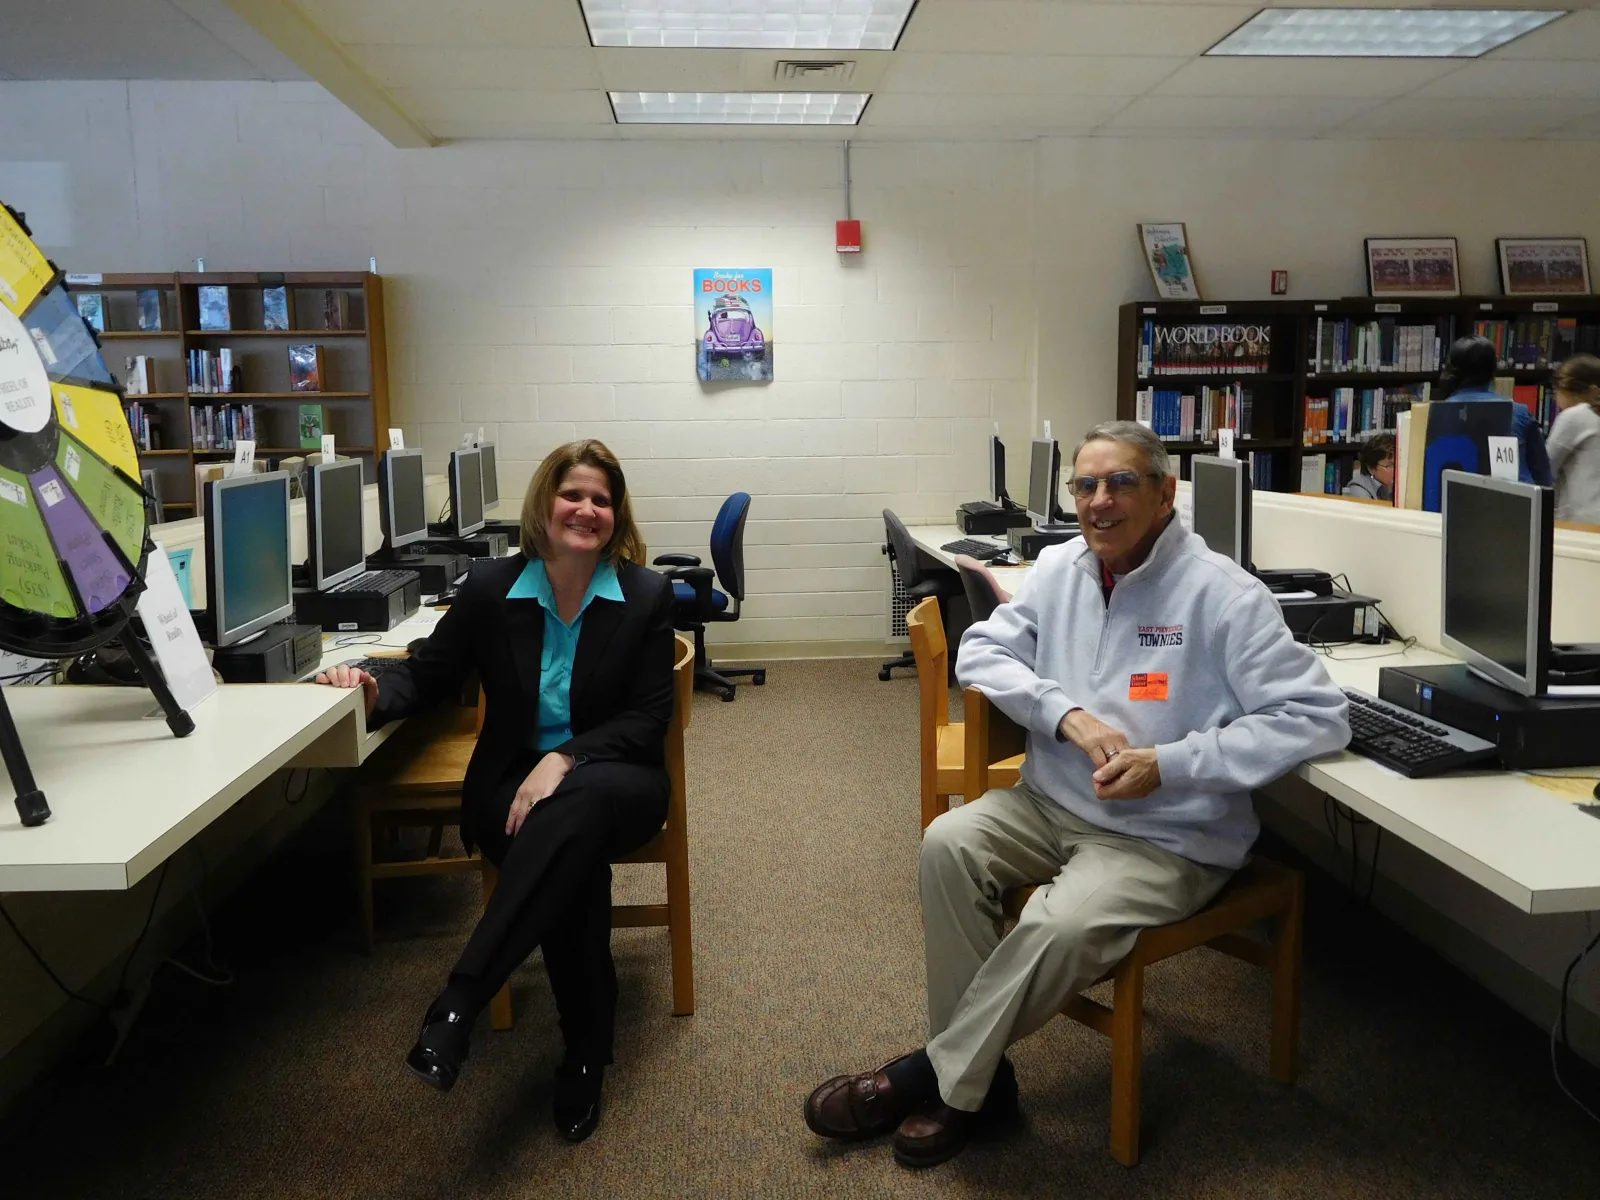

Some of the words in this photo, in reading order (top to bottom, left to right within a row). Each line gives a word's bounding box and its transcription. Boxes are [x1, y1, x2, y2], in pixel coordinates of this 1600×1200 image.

[702, 278, 762, 293] BOOKS
[1155, 326, 1218, 344] WORLD
[1221, 325, 1270, 343] BOOK
[4, 396, 36, 412] REALITY
[1220, 436, 1228, 448] A9
[240, 450, 250, 464] A1
[1496, 446, 1514, 464] A10
[7, 534, 42, 557] Ticket
[6, 551, 50, 580] Parking
[166, 627, 183, 641] Reality
[1139, 632, 1183, 647] TOWNIES
[16, 658, 29, 672] THE
